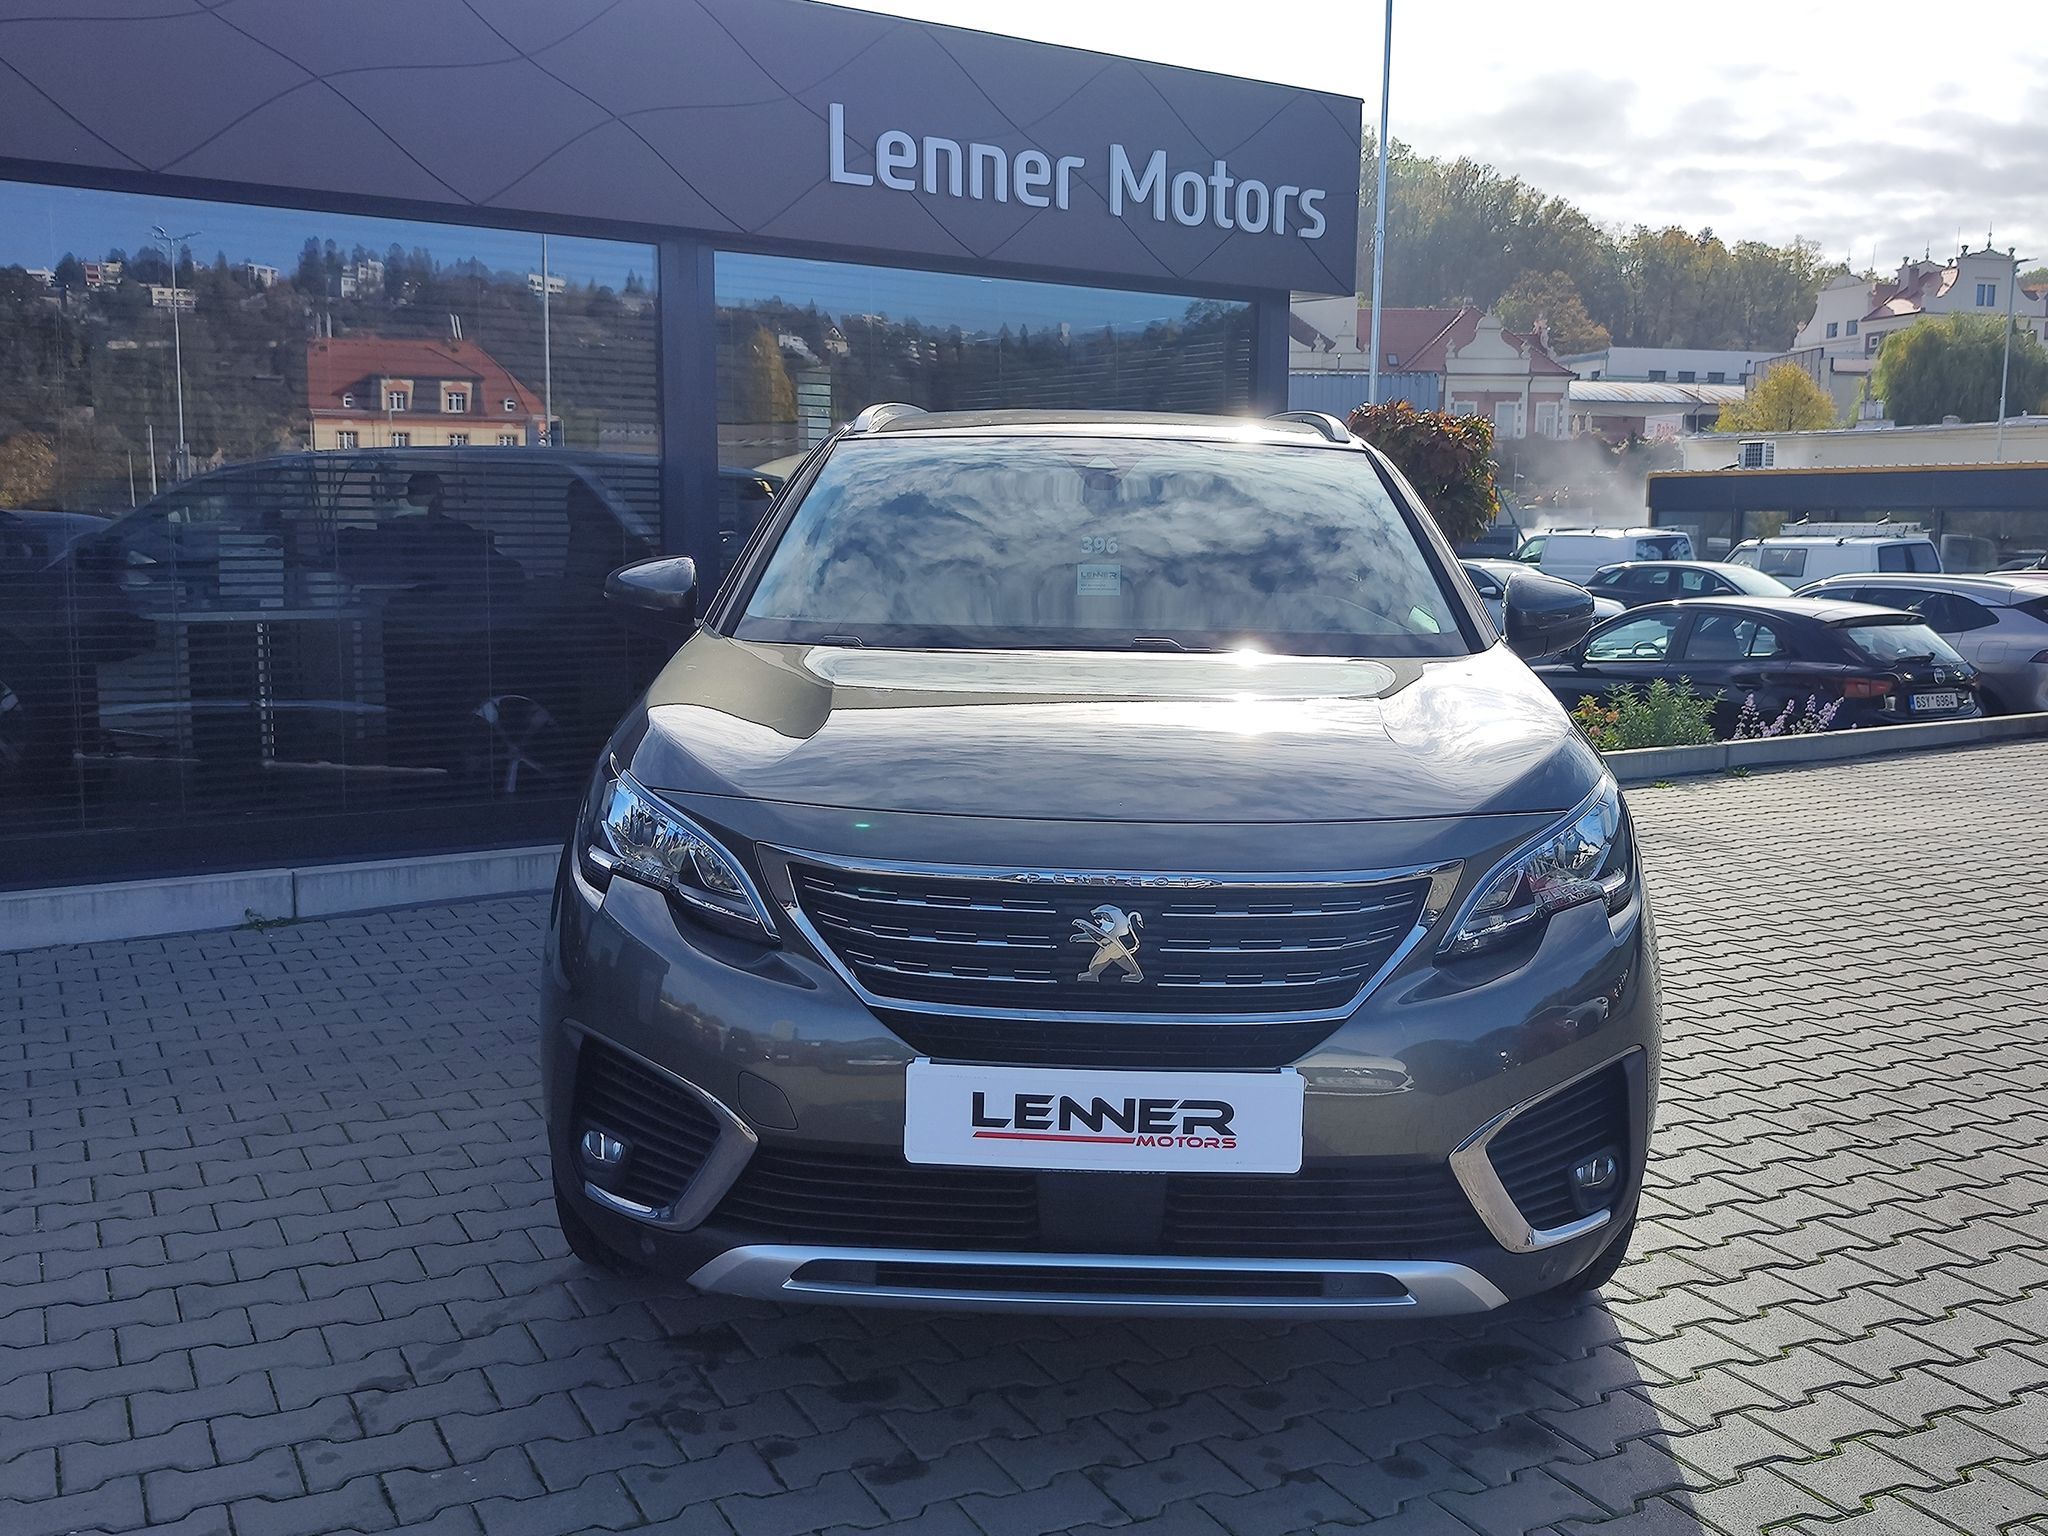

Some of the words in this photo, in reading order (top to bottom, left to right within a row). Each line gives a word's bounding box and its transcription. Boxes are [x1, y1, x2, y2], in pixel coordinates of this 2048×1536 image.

[829, 102, 1085, 211] Lenner
[1109, 143, 1327, 239] Motors
[1081, 536, 1119, 554] 396
[970, 1090, 1237, 1137] LENNER
[1136, 1134, 1238, 1150] MOTORS
